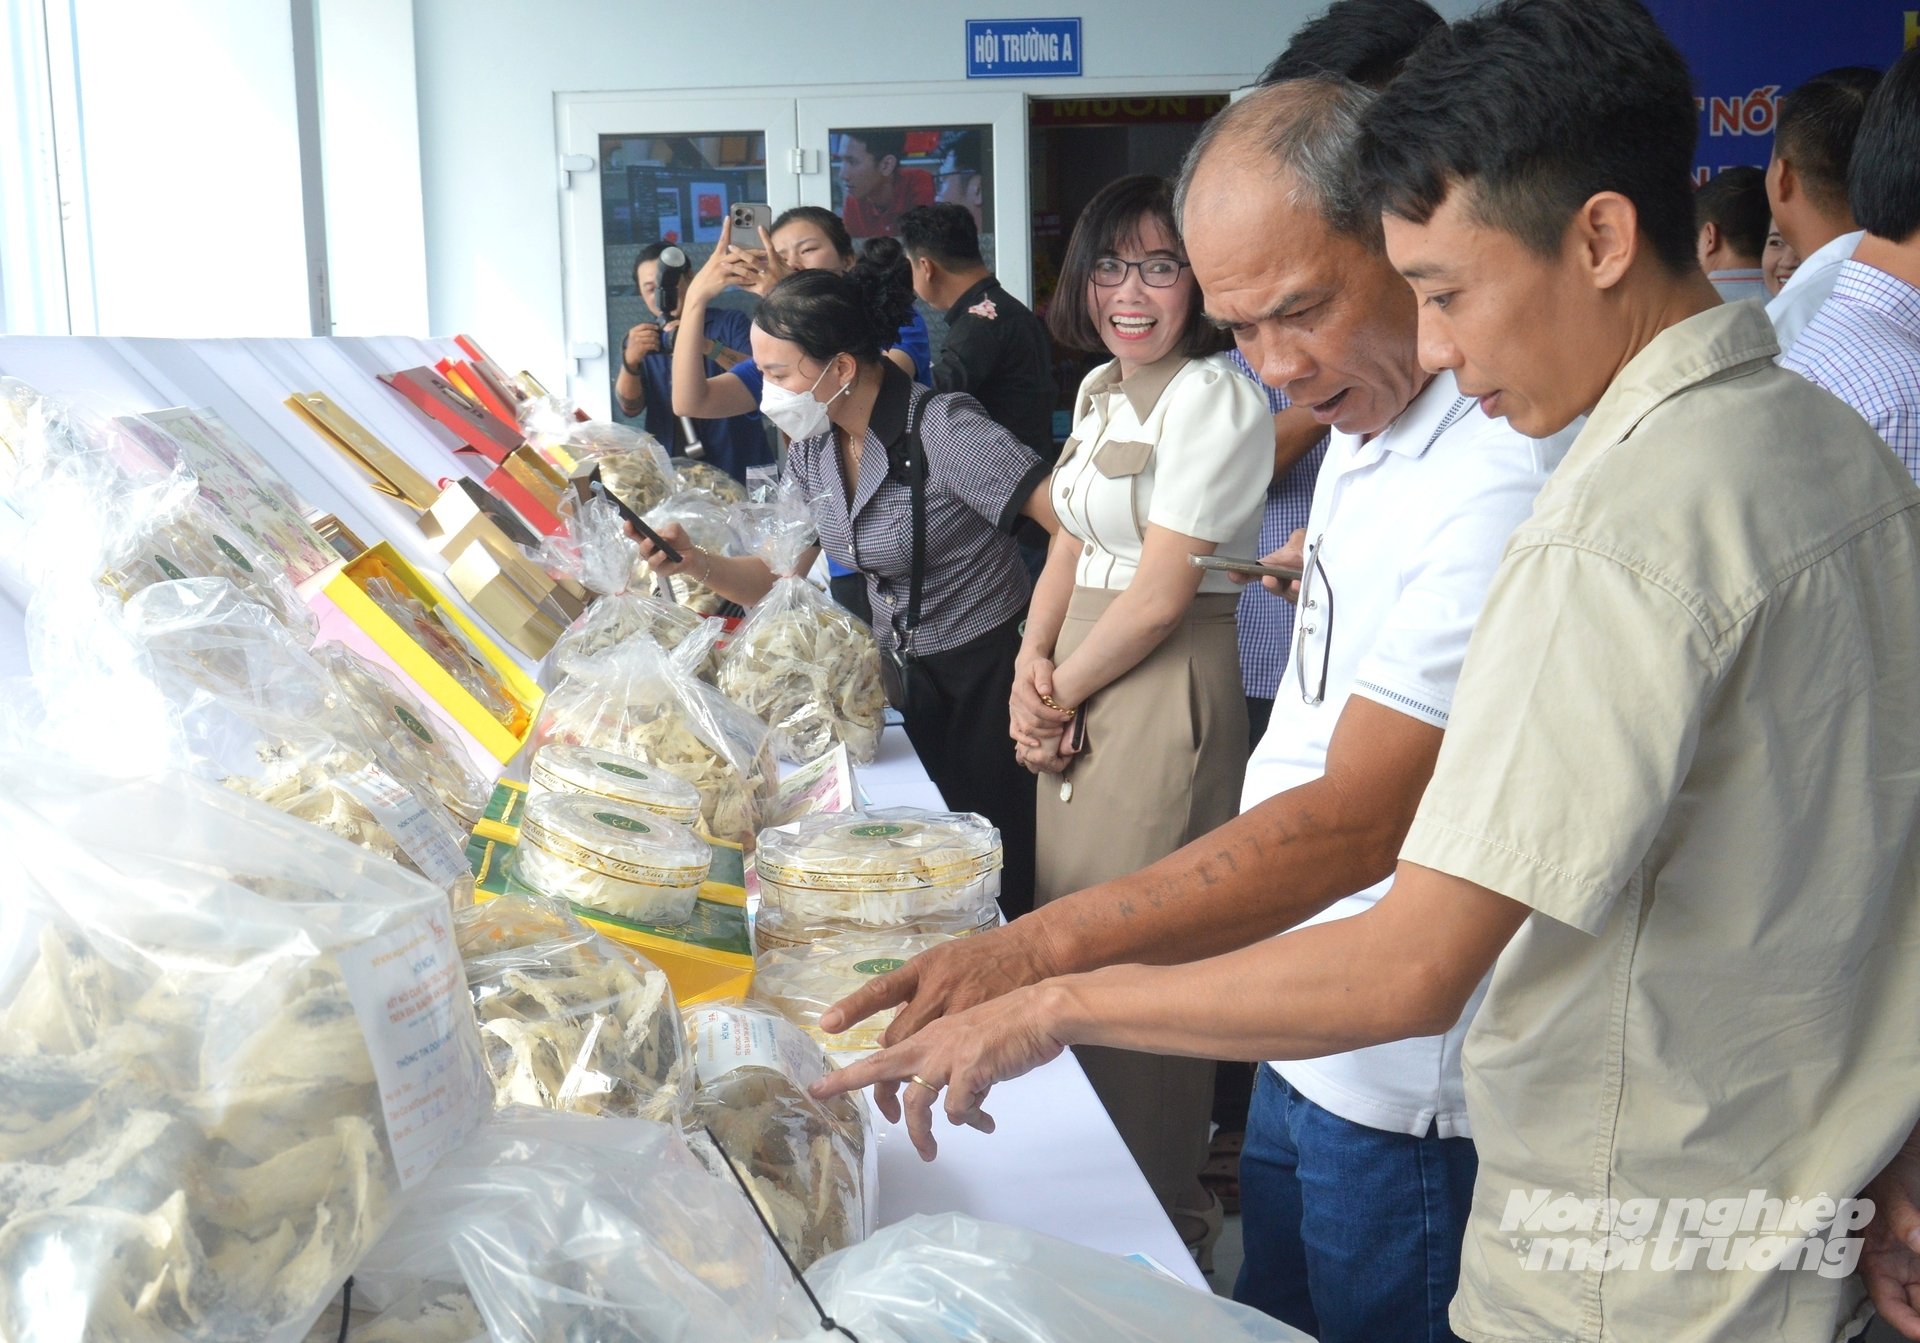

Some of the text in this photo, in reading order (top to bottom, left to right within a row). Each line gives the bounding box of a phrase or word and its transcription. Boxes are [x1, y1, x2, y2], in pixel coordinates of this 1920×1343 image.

[975, 27, 1073, 69] HỘI TRƯỜNG A
